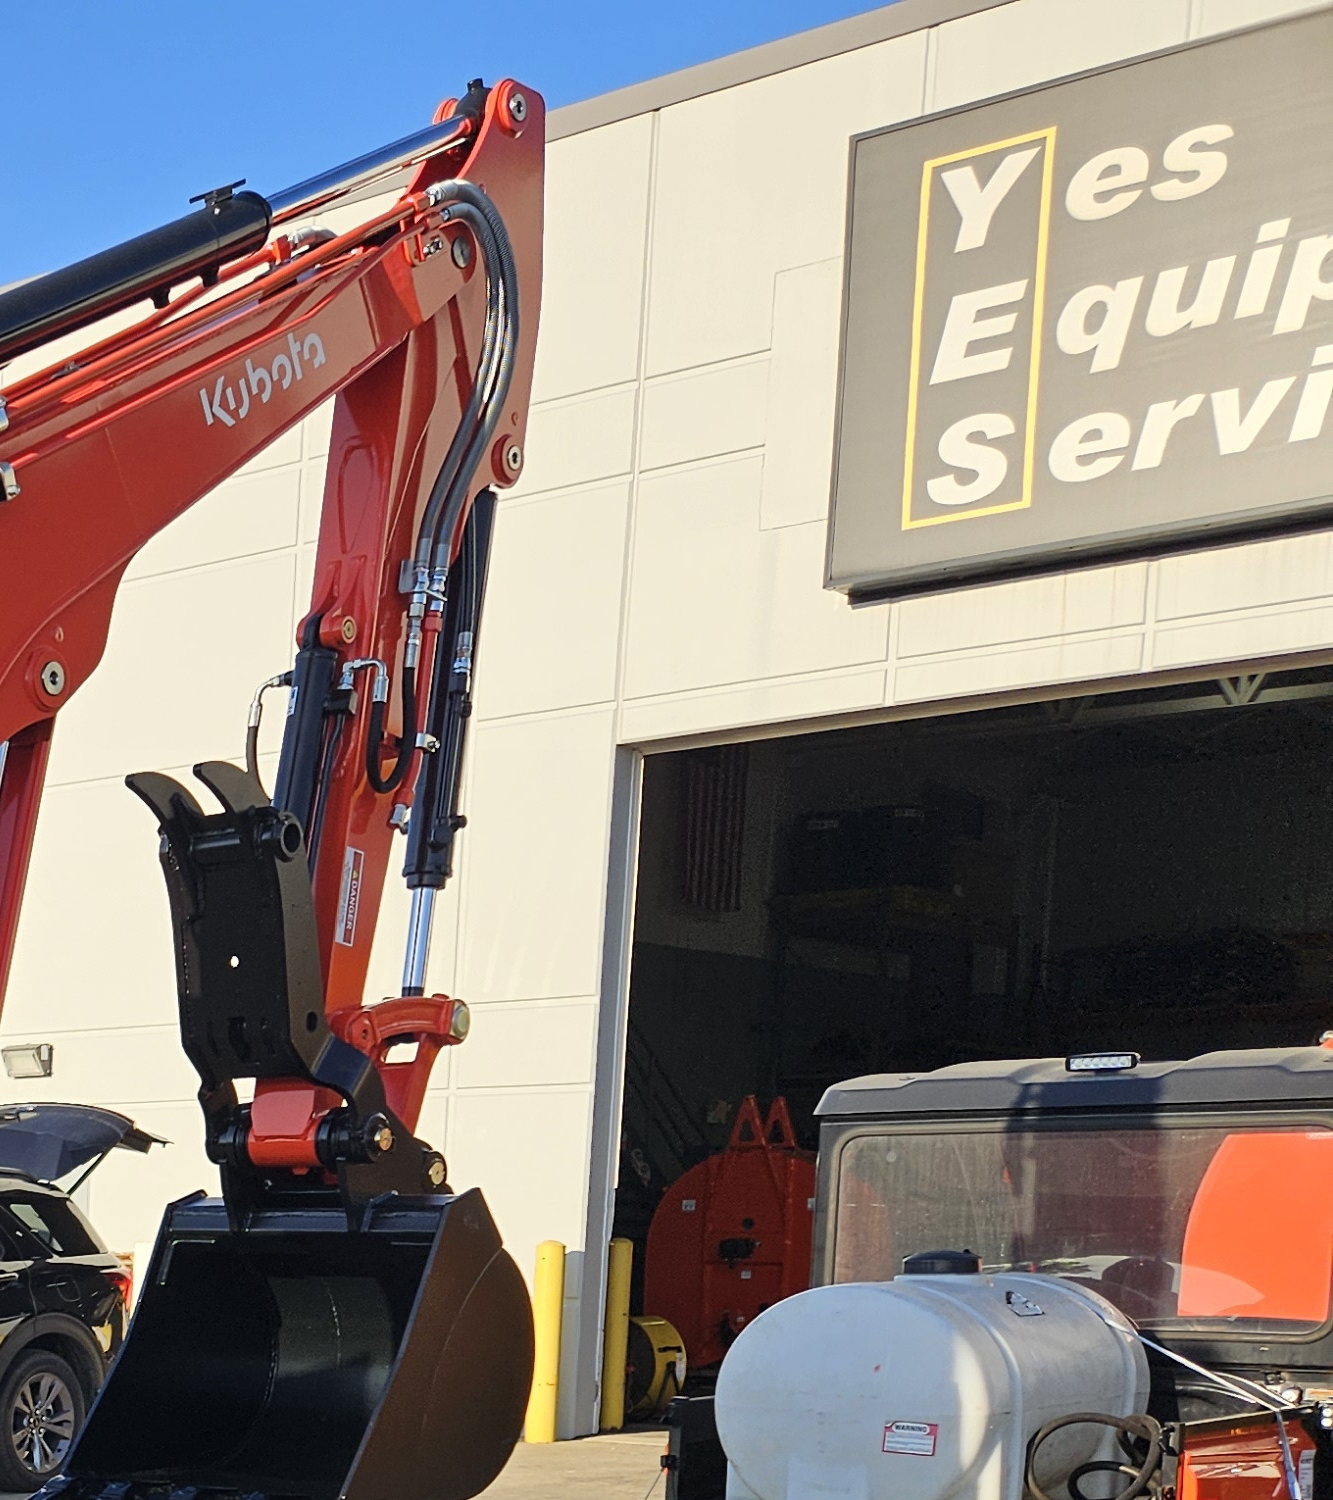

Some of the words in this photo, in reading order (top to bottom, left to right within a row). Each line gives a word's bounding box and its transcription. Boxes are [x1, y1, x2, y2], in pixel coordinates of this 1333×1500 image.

[940, 124, 1234, 253] Yes
[199, 332, 326, 427] Kubota
[346, 880, 358, 930] DANGER
[894, 1424, 928, 1433] WARNING
